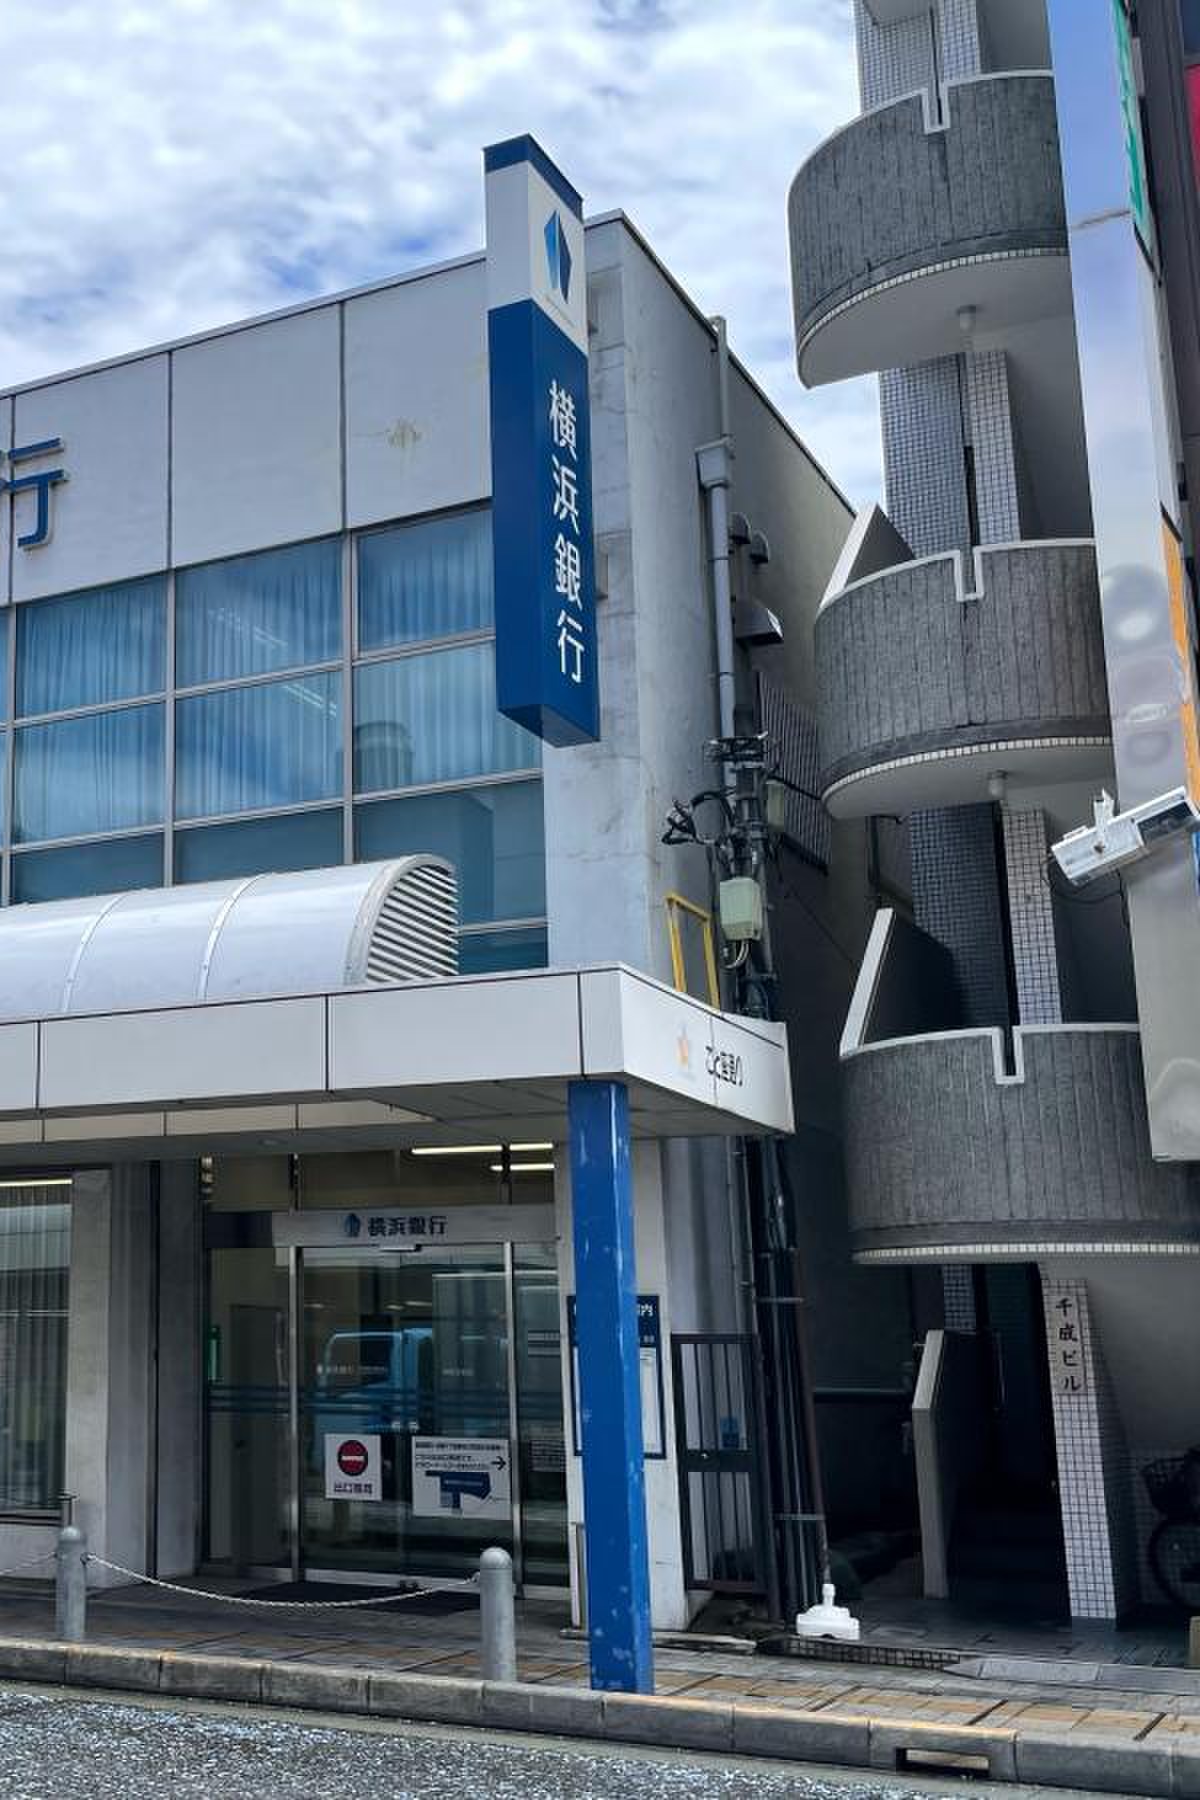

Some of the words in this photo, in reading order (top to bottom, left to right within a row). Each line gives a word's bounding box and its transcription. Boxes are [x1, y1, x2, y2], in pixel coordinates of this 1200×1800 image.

[548, 379, 585, 684] 横浜銀行
[368, 1215, 448, 1237] 横浜銀行
[1056, 1297, 1082, 1391] 千成ビル
